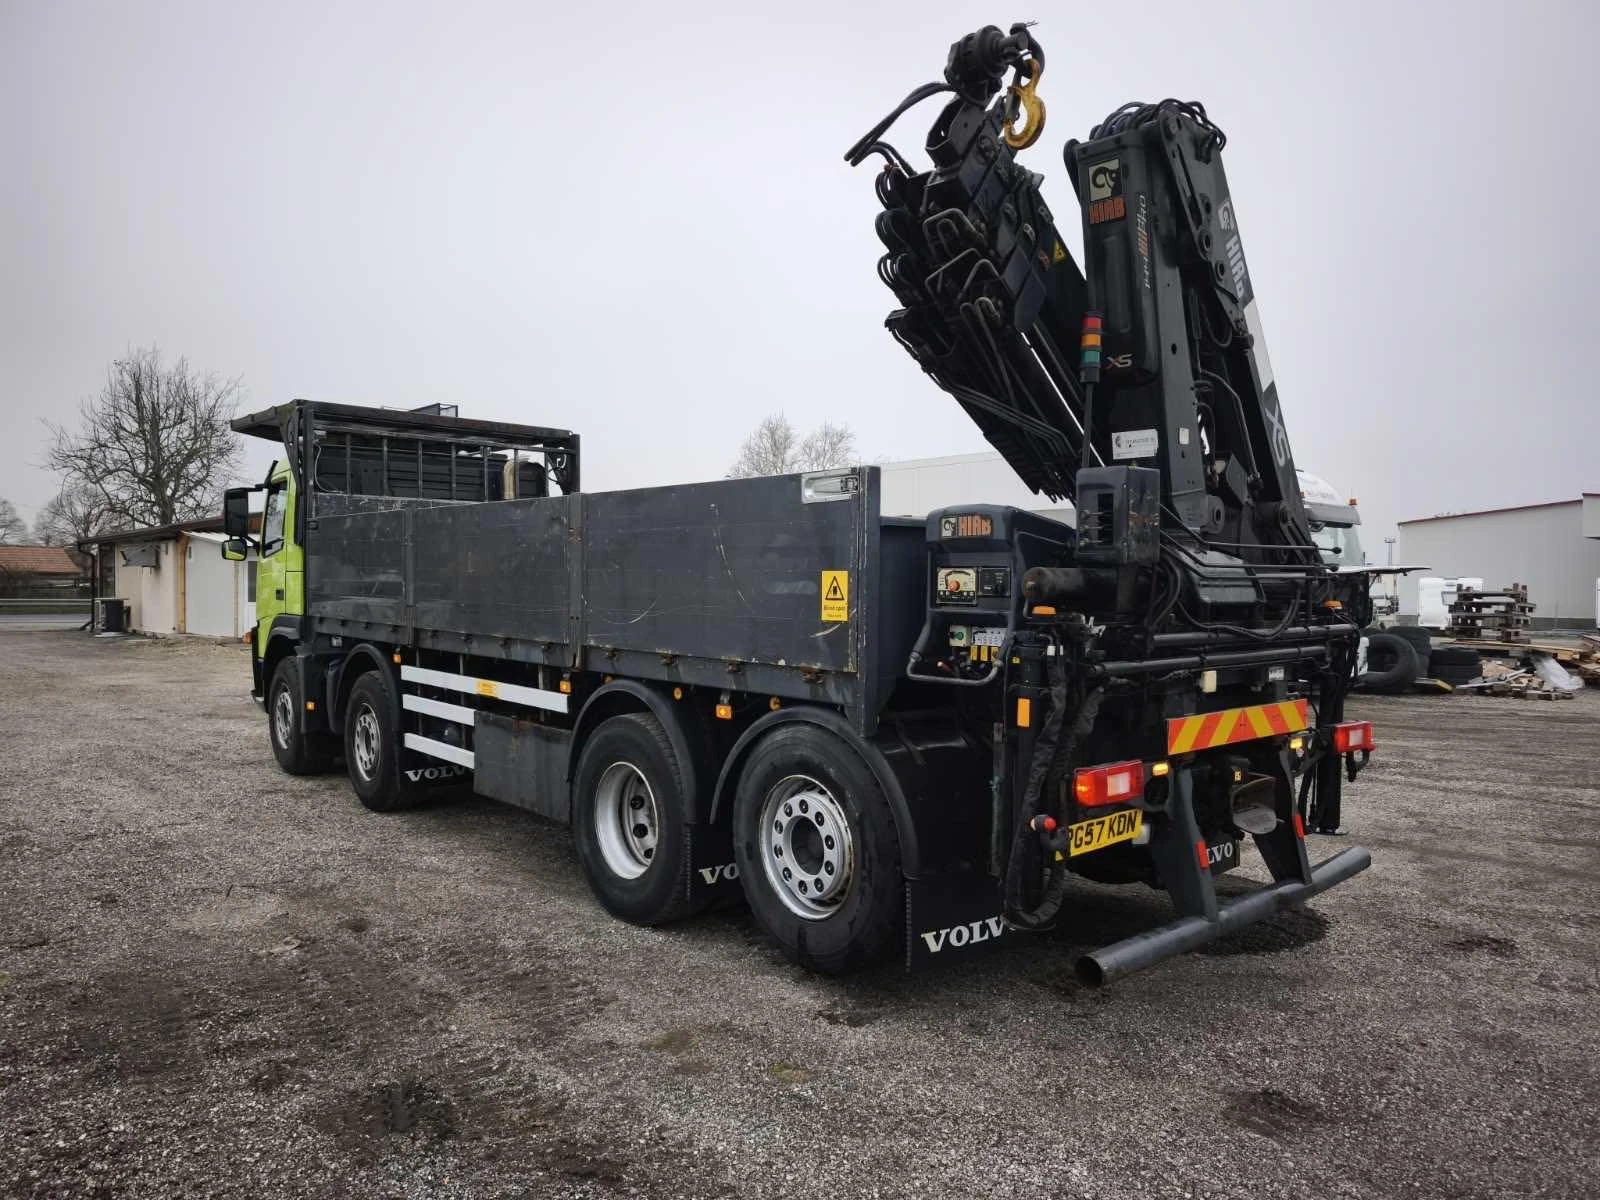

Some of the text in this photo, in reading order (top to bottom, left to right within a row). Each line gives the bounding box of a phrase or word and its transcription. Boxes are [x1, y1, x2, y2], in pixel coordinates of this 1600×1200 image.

[1106, 353, 1134, 370] XS
[1264, 398, 1291, 467] XS
[957, 515, 992, 537] HIAB
[404, 765, 466, 782] VOLV
[1107, 810, 1138, 840] KDN
[1205, 841, 1234, 865] LVO
[920, 916, 1005, 953] VOLV
